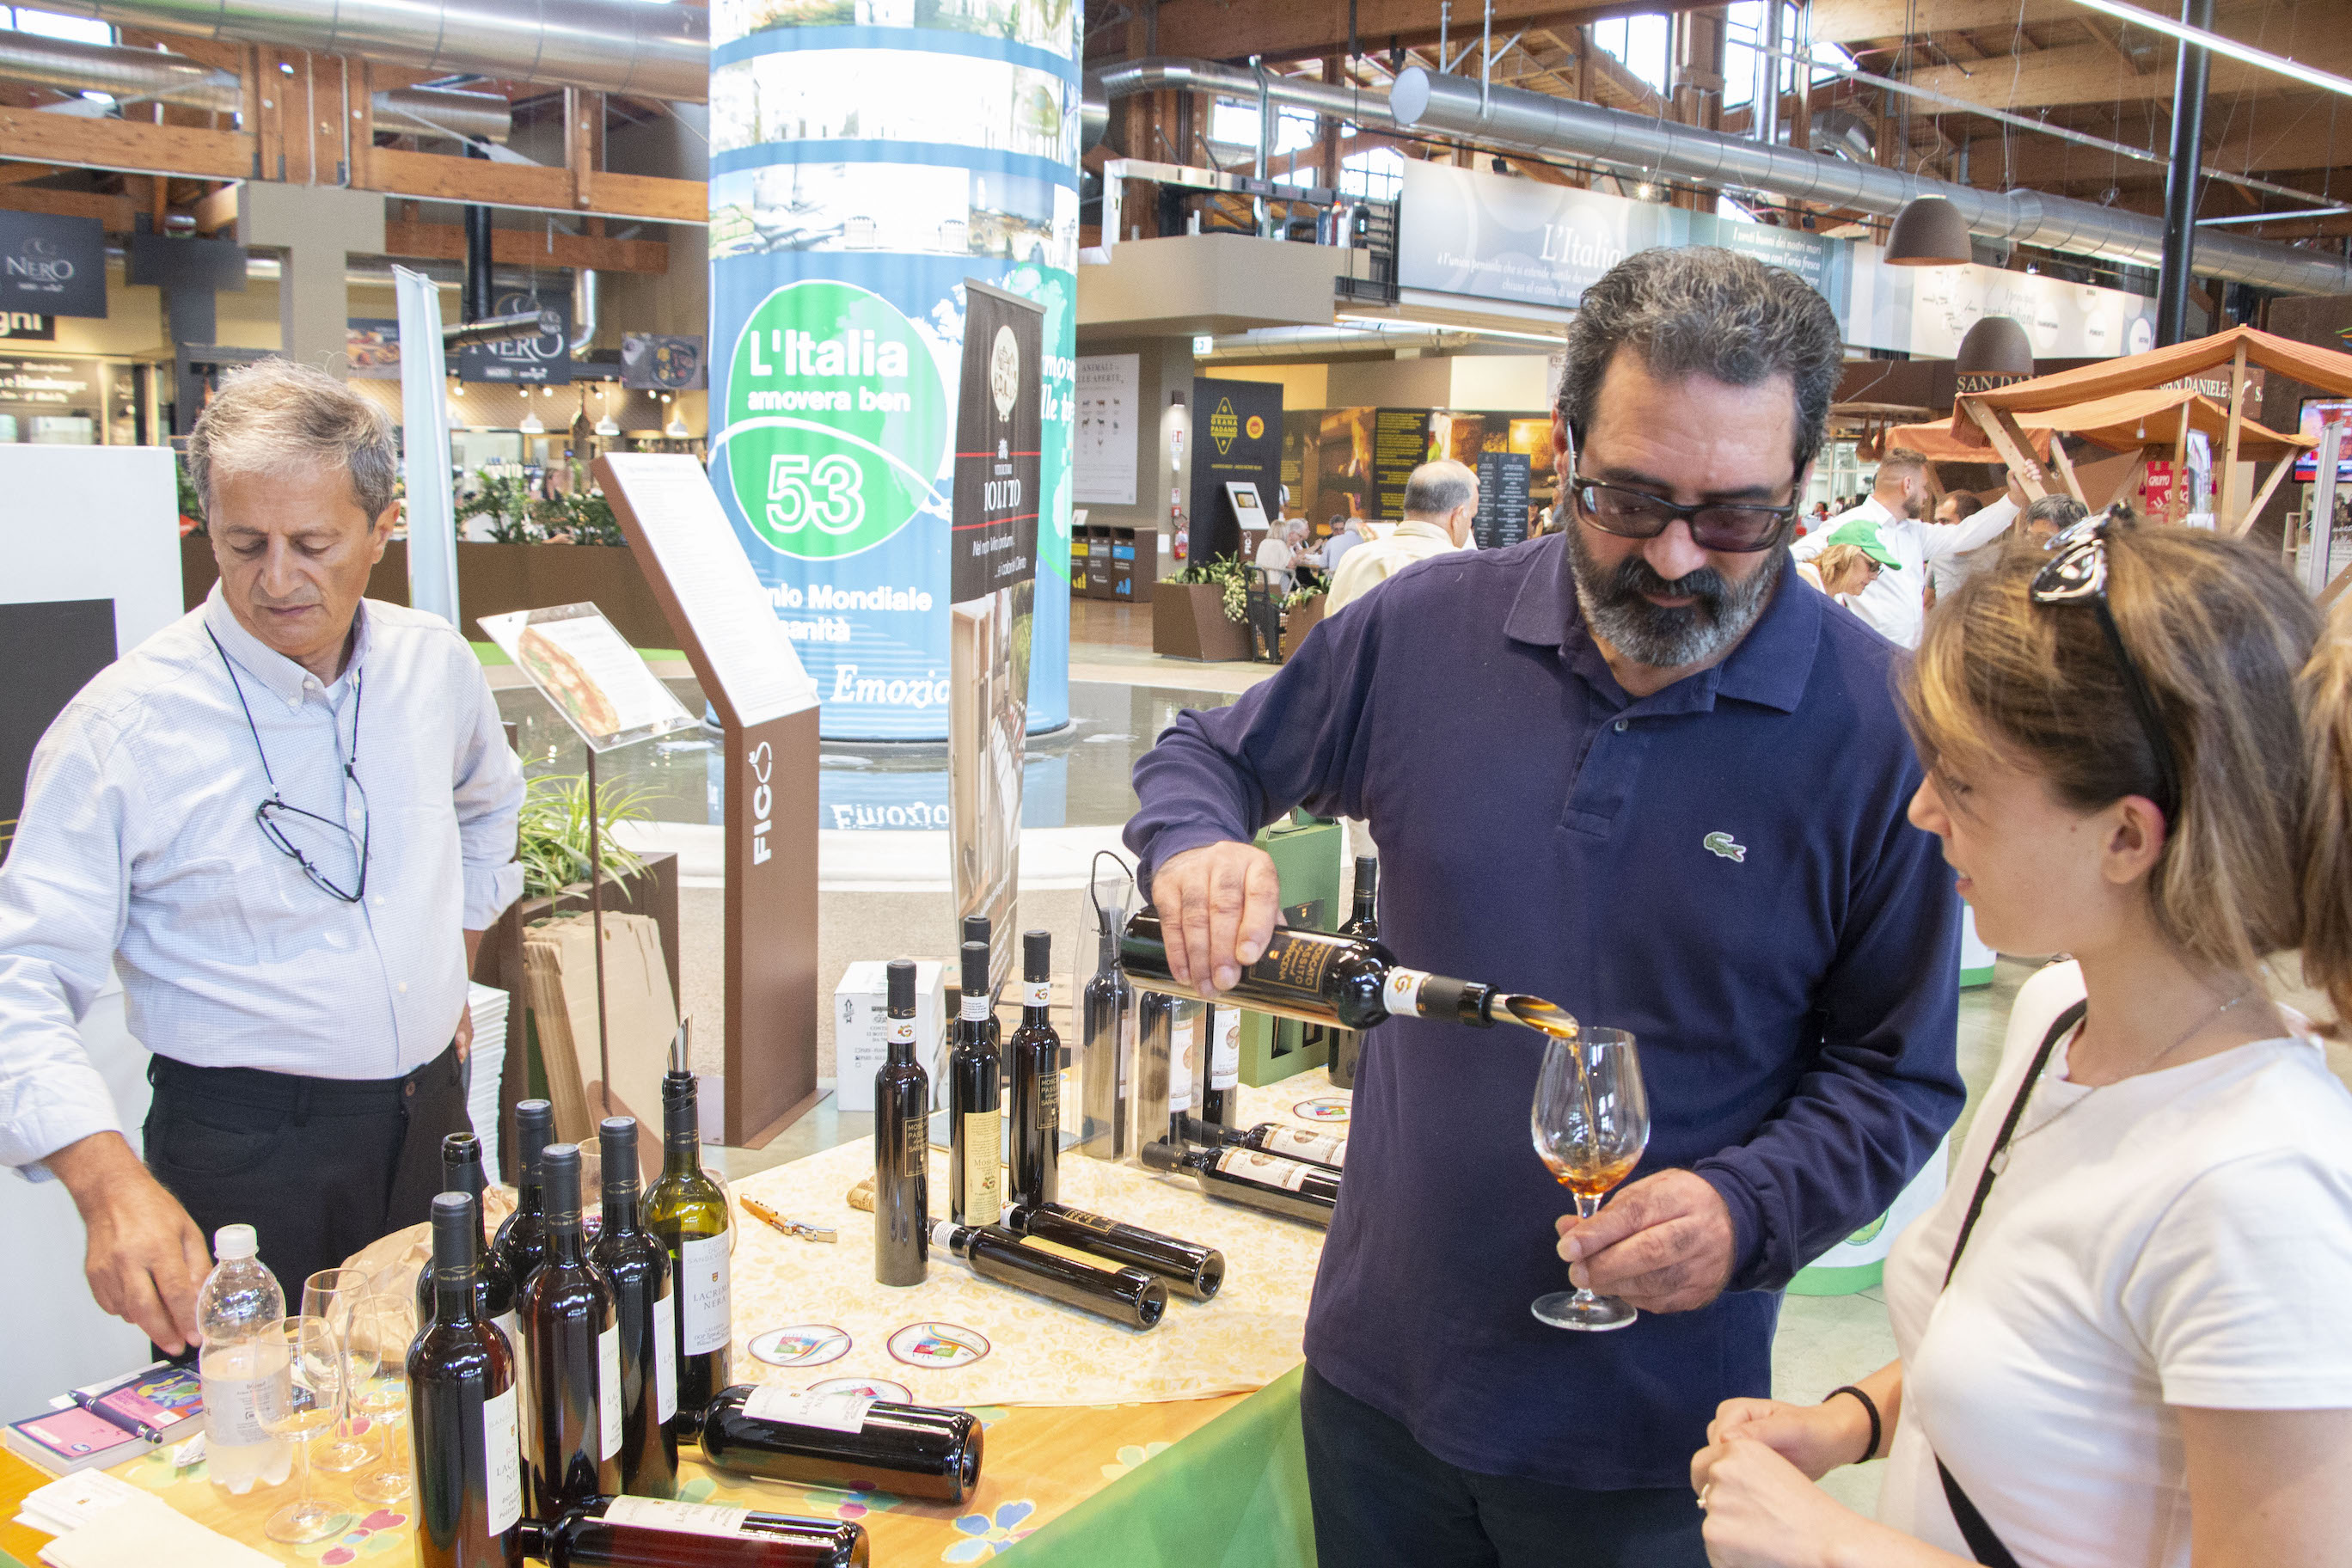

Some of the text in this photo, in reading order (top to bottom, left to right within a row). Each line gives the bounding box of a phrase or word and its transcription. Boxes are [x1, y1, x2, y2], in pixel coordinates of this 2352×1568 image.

[1539, 223, 1622, 270] L'Italia
[7, 255, 75, 282] NERO
[749, 329, 910, 377] L'Italia
[1956, 376, 1994, 391] SAN
[748, 386, 911, 412] annovera ben
[765, 454, 866, 536] 53
[763, 582, 933, 611] nio Mondiale
[703, 1296, 727, 1311] NERA
